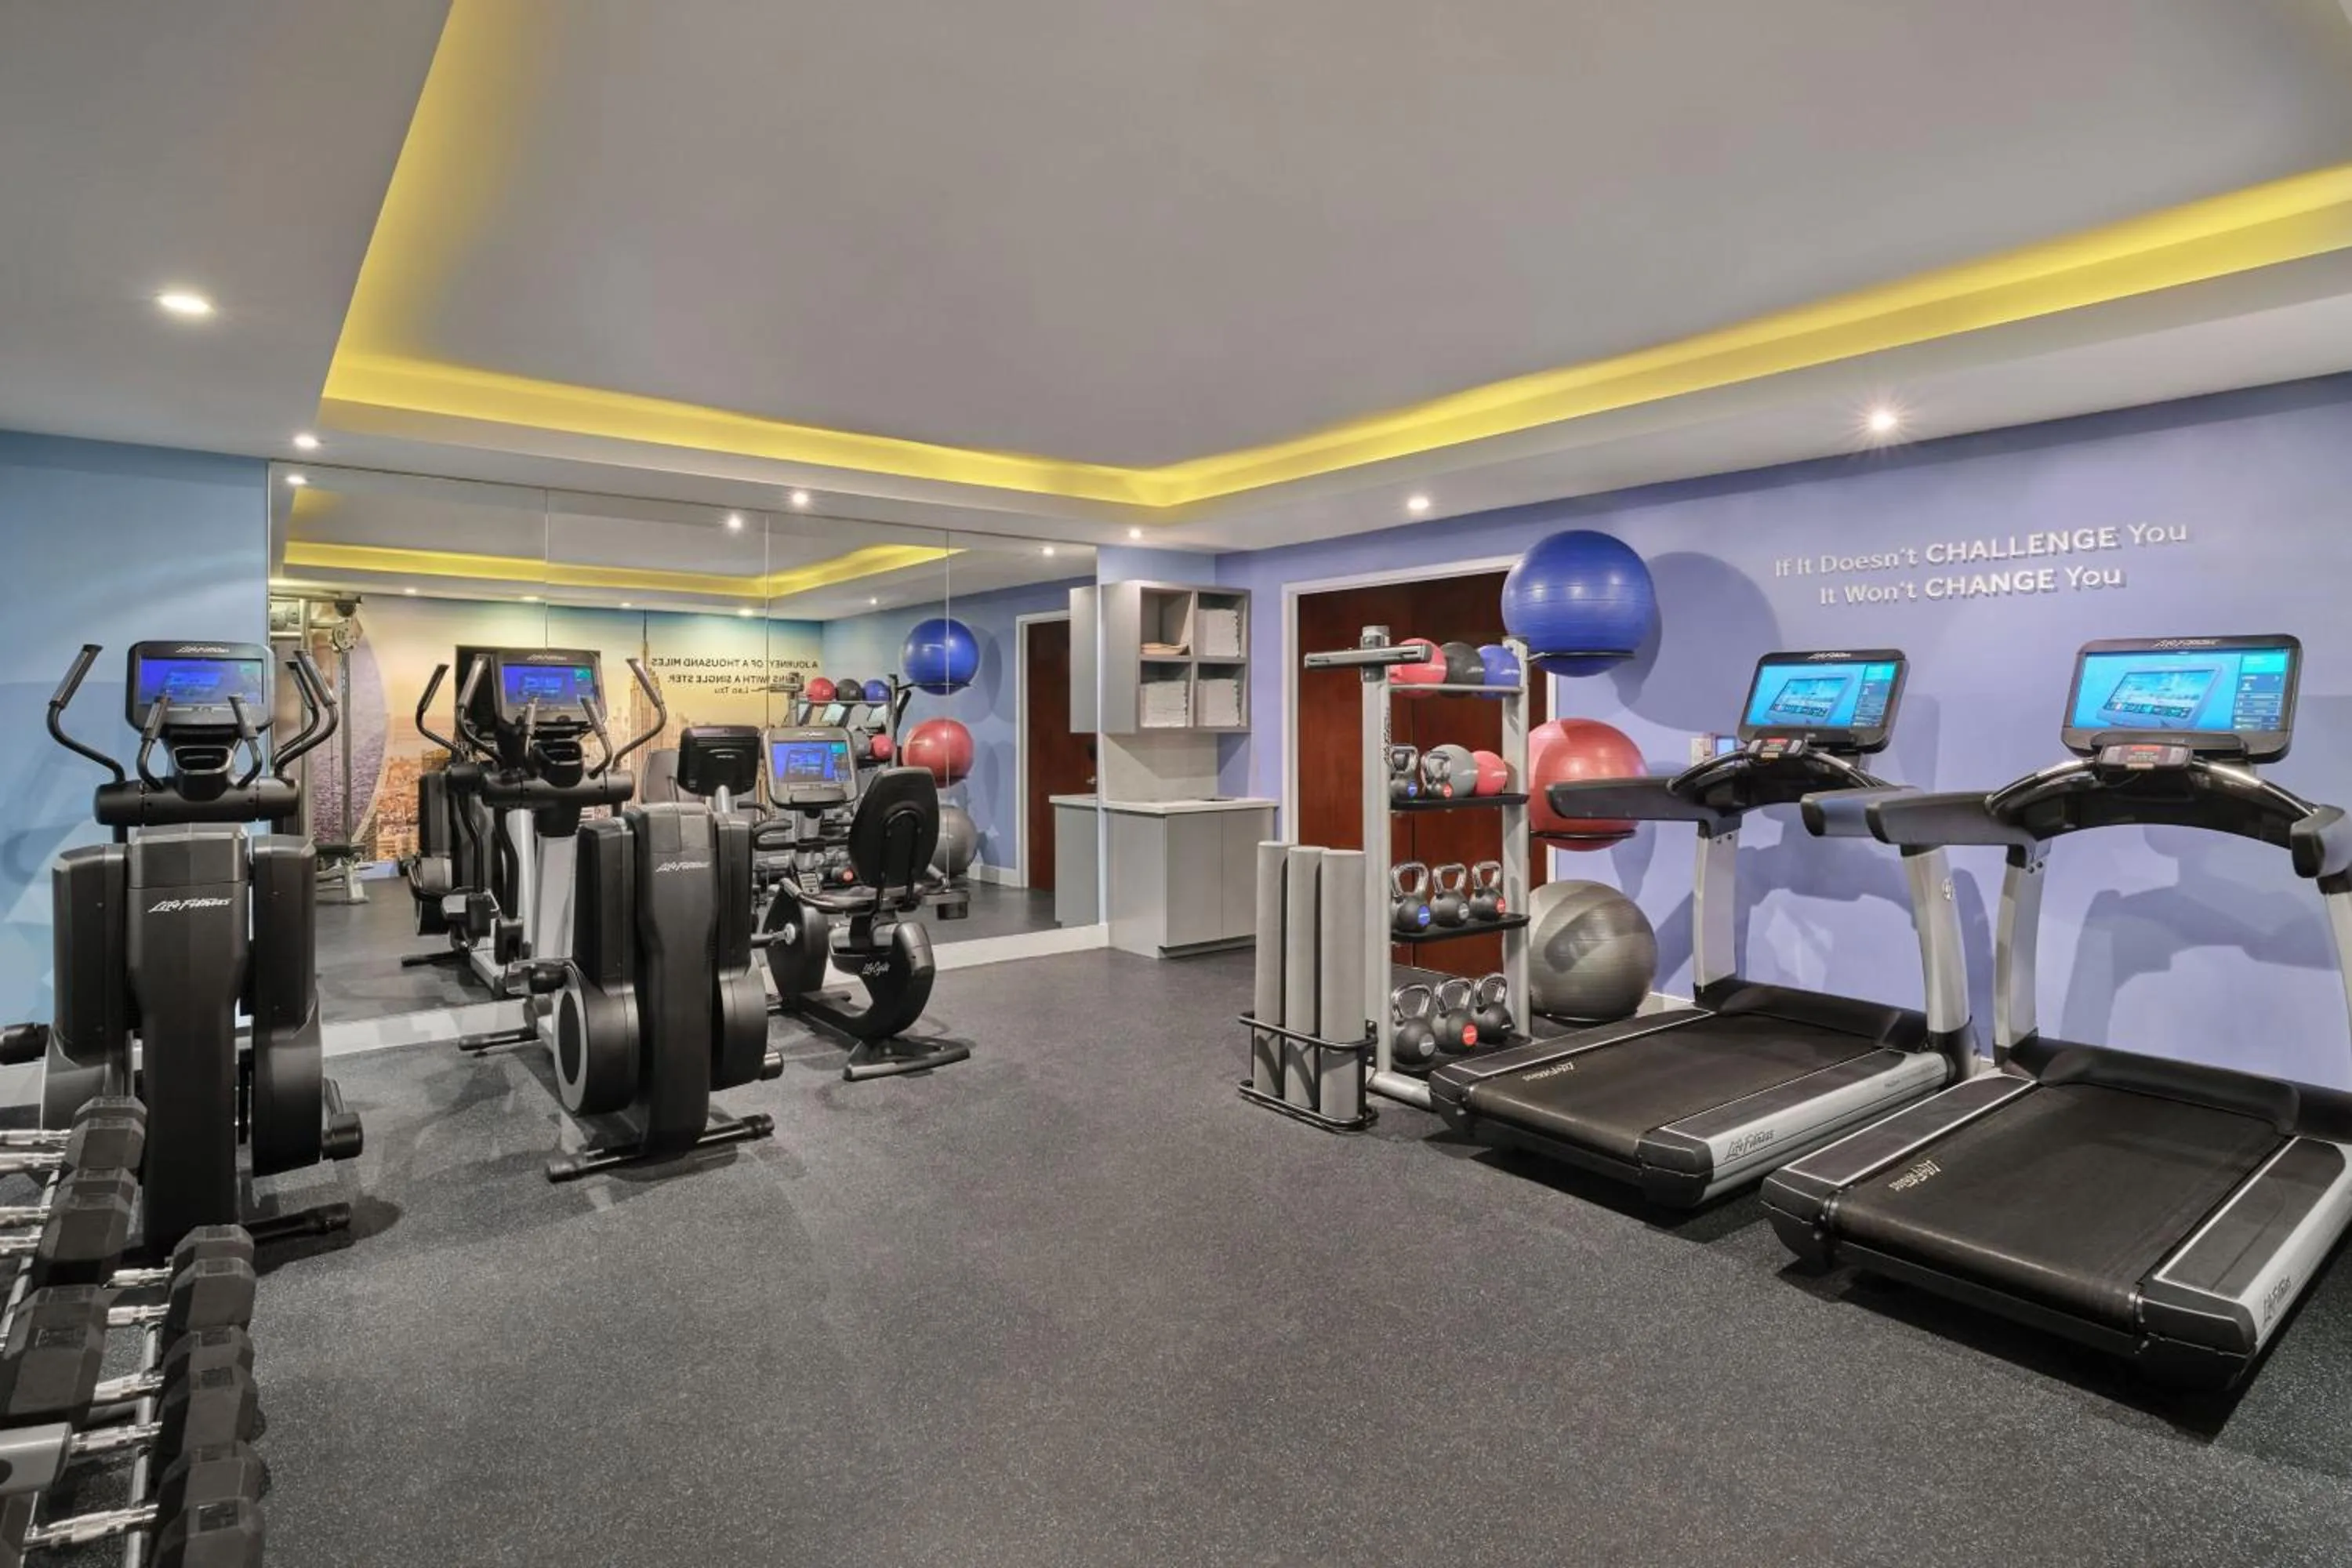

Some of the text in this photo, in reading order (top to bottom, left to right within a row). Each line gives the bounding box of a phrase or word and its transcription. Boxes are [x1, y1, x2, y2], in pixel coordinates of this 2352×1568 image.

[1775, 521, 2187, 577] If It Doesn't CHALLENGE You
[1820, 565, 2123, 605] It Won't CHANGE You
